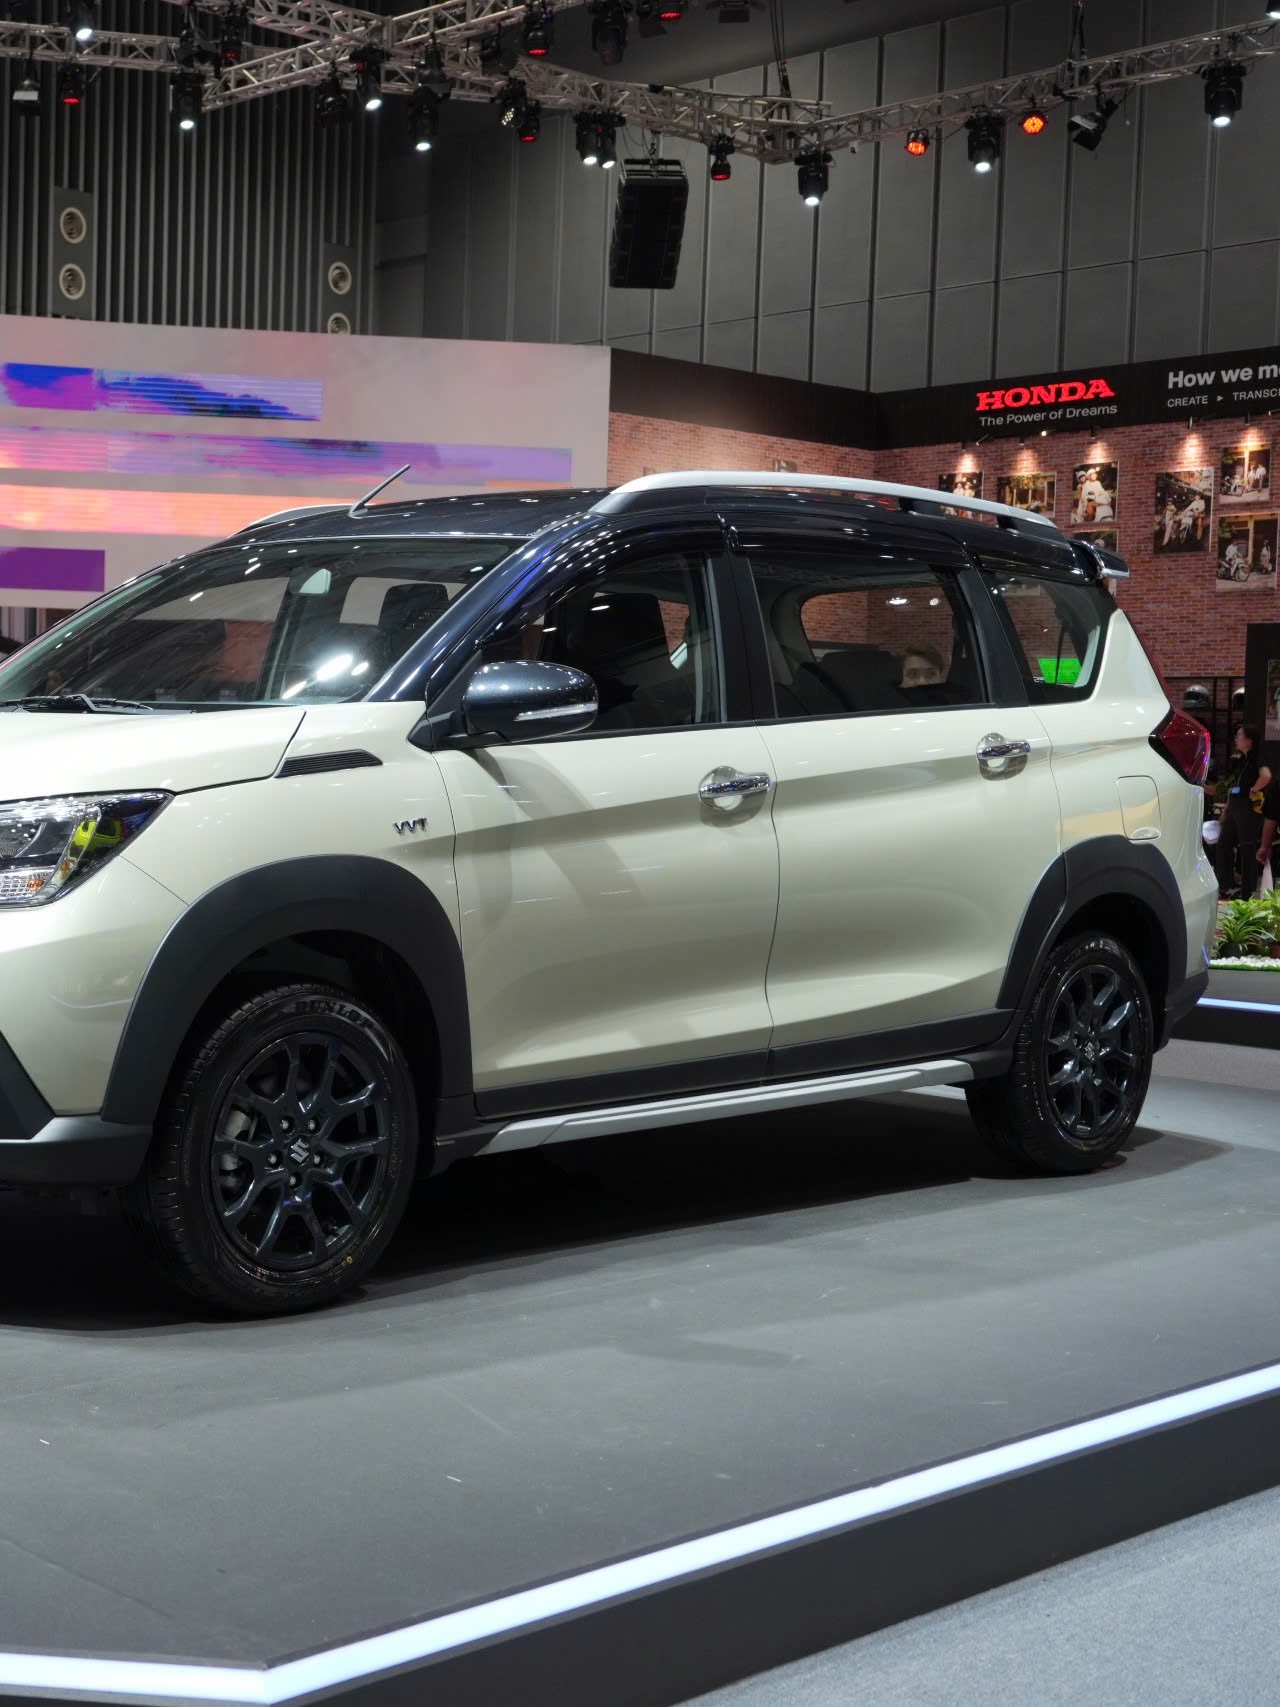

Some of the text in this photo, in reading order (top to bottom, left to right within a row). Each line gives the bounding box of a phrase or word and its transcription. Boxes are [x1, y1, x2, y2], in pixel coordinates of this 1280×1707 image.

[1167, 363, 1280, 389] How we m
[976, 378, 1116, 411] HONDA
[1167, 388, 1280, 408] CREATE TRANSC
[979, 404, 1118, 427] The Power of Dreams
[393, 817, 427, 834] VVT
